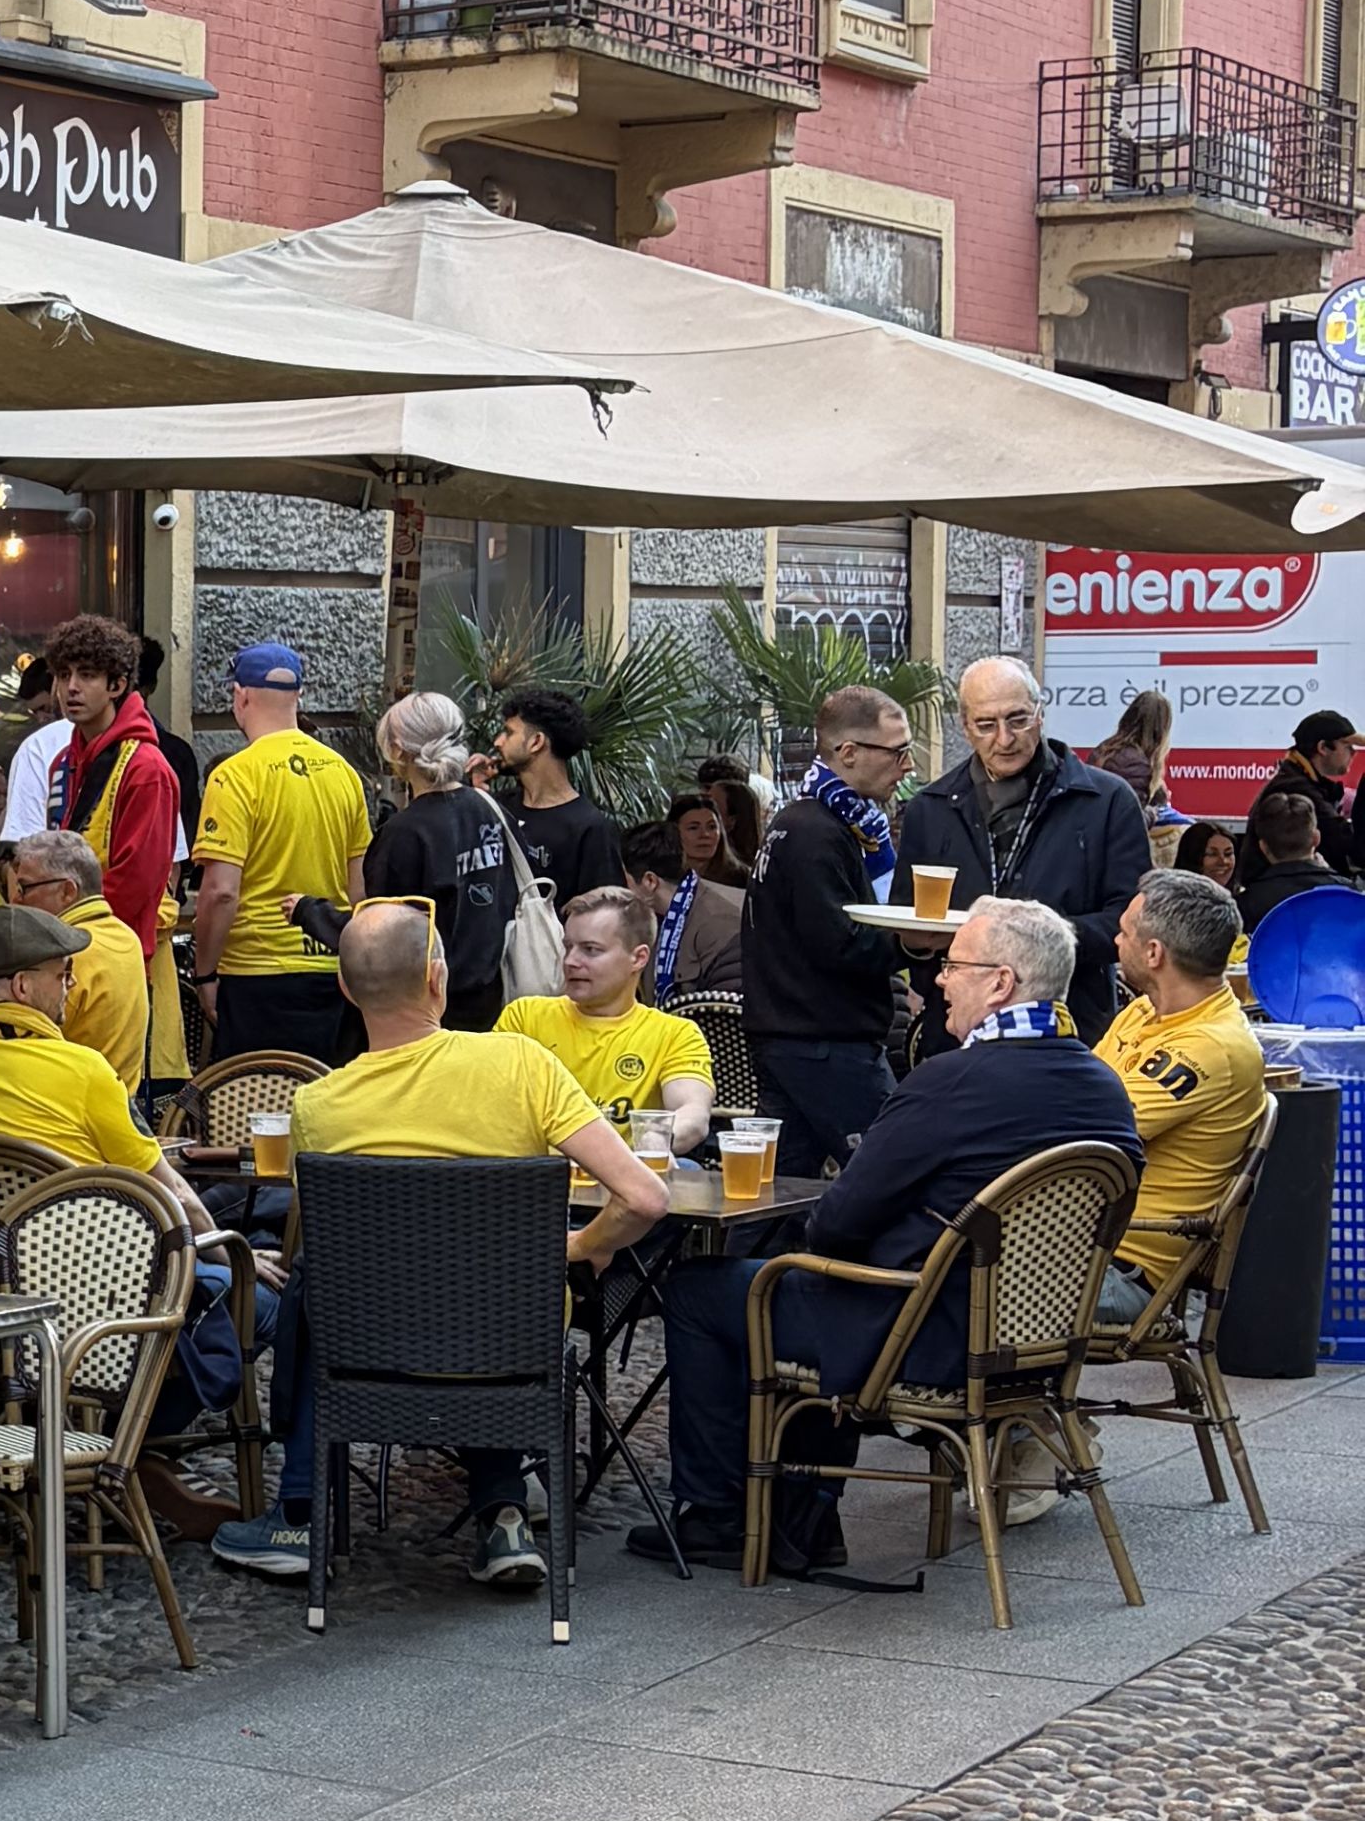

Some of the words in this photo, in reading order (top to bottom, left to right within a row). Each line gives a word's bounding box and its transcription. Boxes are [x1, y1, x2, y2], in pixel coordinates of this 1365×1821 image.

[53, 116, 158, 229] Pub
[1291, 378, 1357, 427] BAR
[1169, 762, 1279, 781] www.mondoc
[270, 1530, 310, 1546] HOKA
